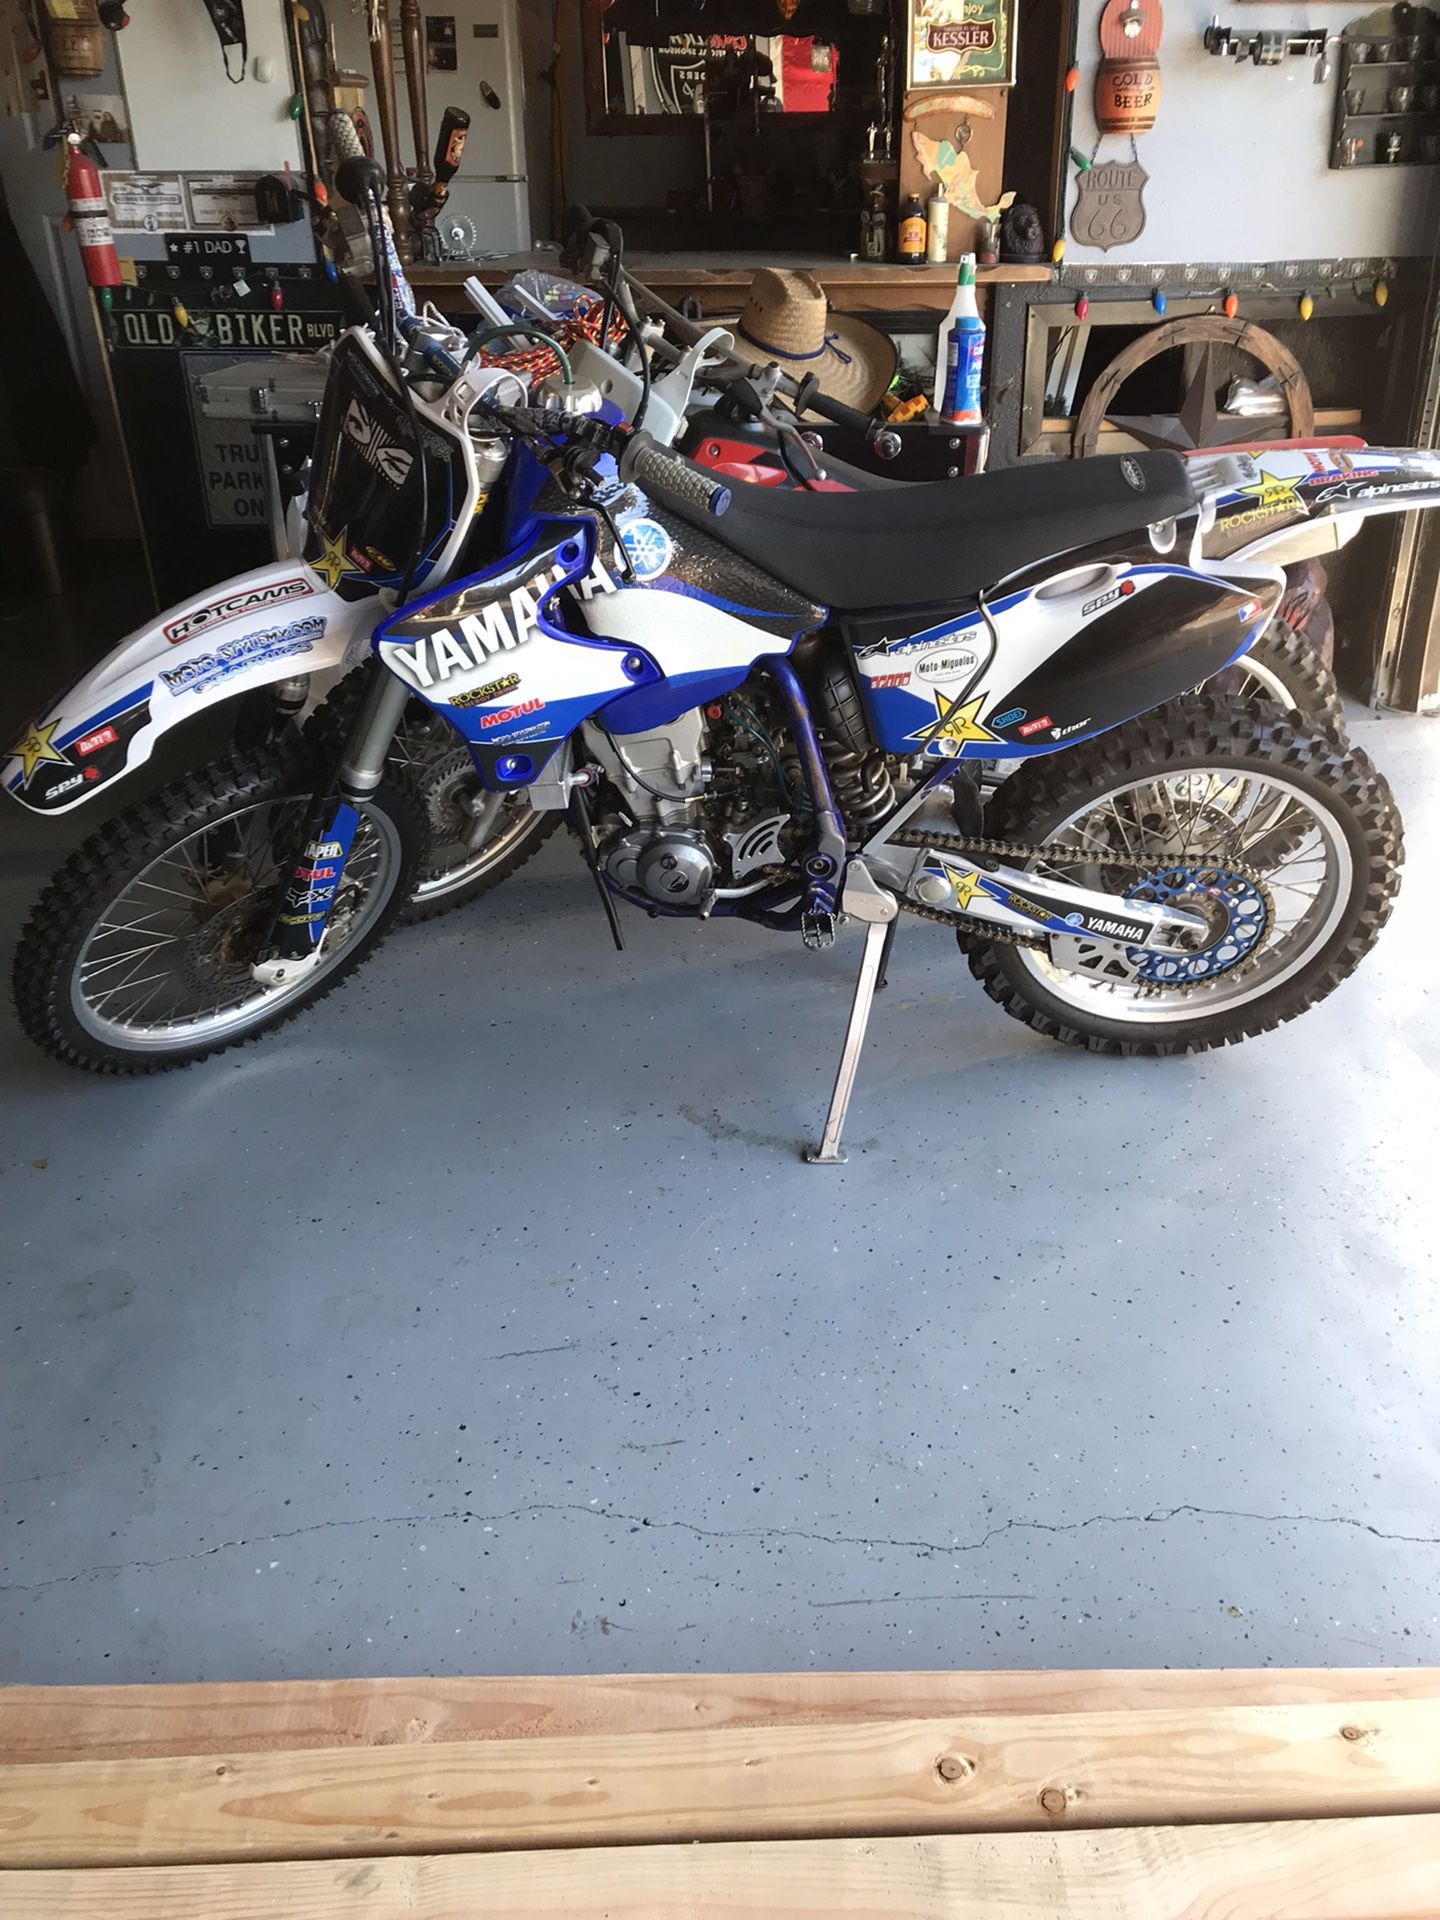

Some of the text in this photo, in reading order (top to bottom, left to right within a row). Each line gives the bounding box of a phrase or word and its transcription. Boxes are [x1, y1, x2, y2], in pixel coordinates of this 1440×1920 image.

[964, 2, 985, 15] njoy
[933, 30, 989, 48] KESSLER
[1112, 73, 1153, 87] COLD
[1114, 93, 1153, 109] BEER
[1086, 169, 1138, 189] ROUTE
[1097, 193, 1123, 207] US
[1087, 208, 1128, 241] 66
[182, 240, 233, 254] #1 DAD
[123, 312, 336, 346] OLD BIKER BLVD
[214, 443, 260, 464] TRU
[208, 470, 266, 491] PARK
[1309, 470, 1379, 486] BRAKING
[1357, 479, 1440, 499] alpinestars
[234, 497, 265, 517] ON
[171, 580, 306, 638] HOTCAMS
[1081, 587, 1122, 616] SPY
[895, 631, 978, 656] alpinestars
[481, 697, 545, 729] MOTUL
[995, 709, 1023, 727] SHOEI
[1061, 717, 1092, 737] thor
[44, 772, 85, 801] SPY
[1087, 916, 1145, 941] YAMAHA
